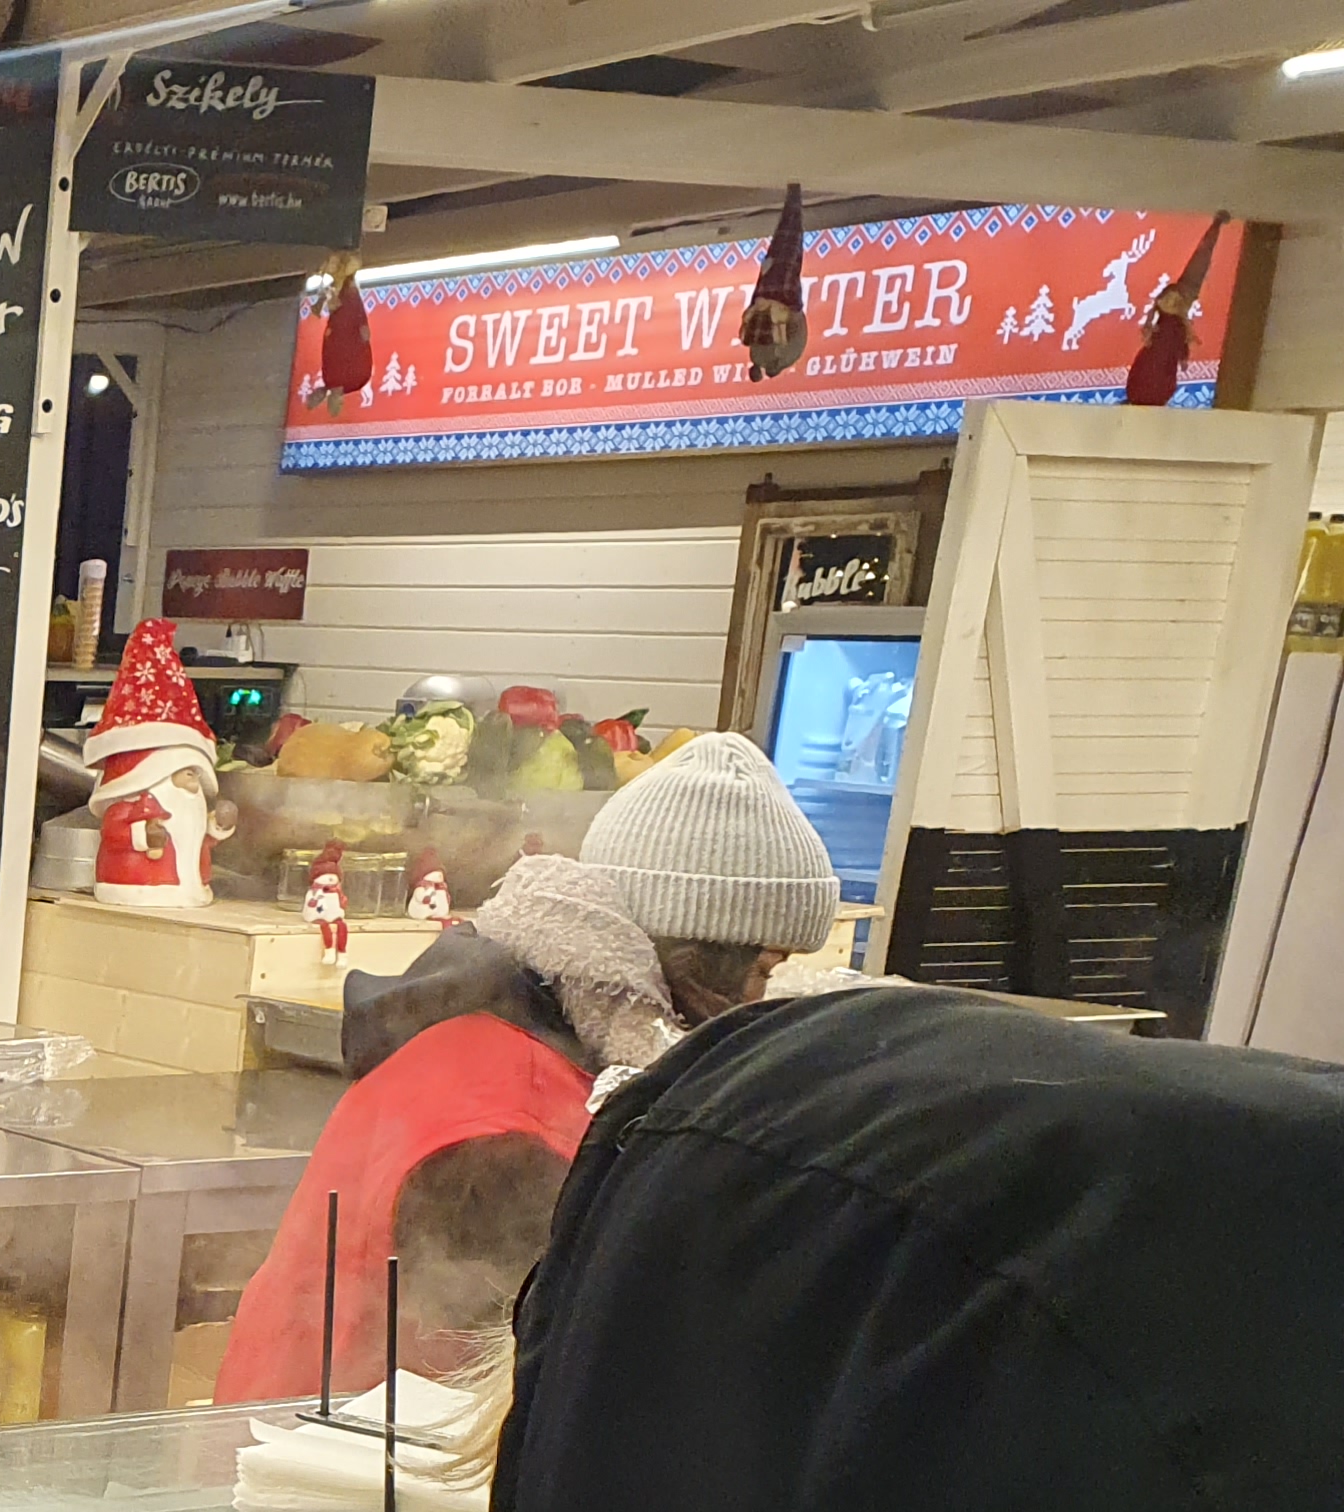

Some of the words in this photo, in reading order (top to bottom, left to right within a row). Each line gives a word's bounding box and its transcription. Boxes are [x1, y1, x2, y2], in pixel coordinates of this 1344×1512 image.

[125, 171, 187, 195] BERTIS
[443, 295, 654, 375] SWEET
[674, 258, 972, 352] WTER
[440, 379, 535, 405] FORRALT
[541, 376, 583, 397] BOR
[603, 366, 703, 393] MULLED
[712, 362, 770, 384] WI
[805, 343, 959, 377] GLÜHWEIN
[787, 558, 865, 600] ubble
